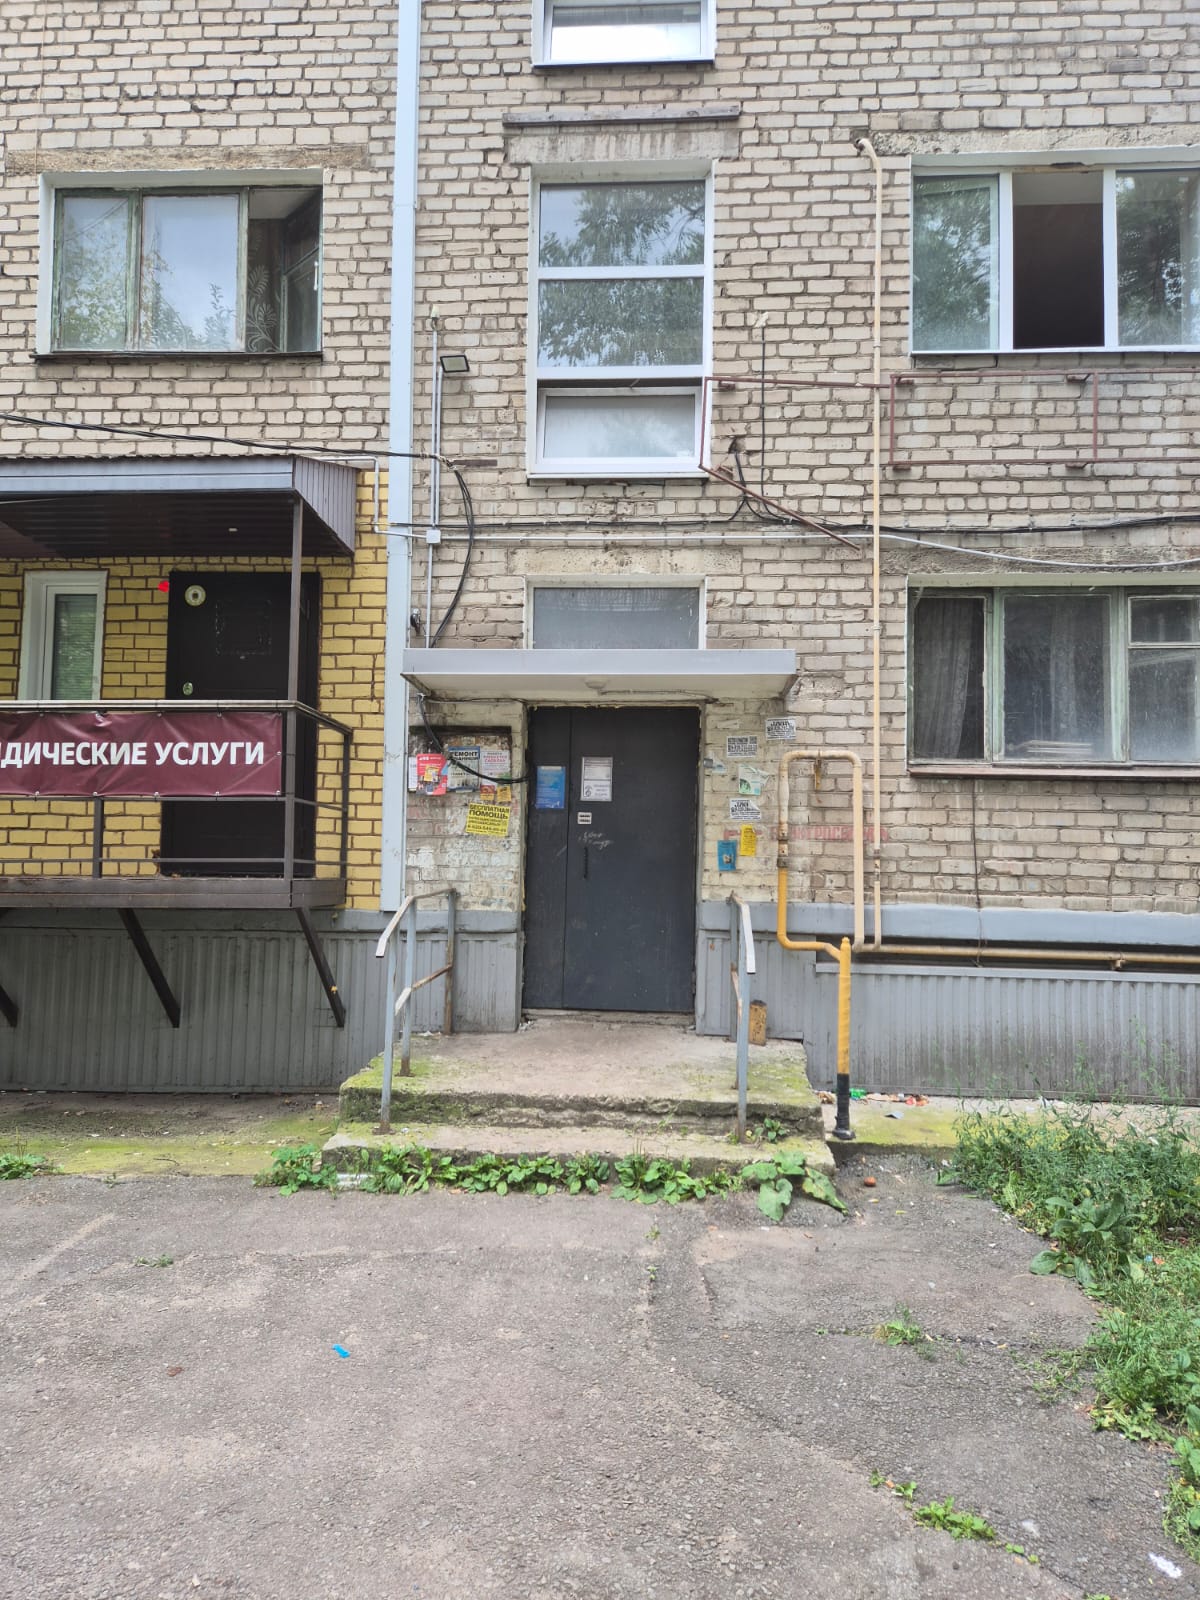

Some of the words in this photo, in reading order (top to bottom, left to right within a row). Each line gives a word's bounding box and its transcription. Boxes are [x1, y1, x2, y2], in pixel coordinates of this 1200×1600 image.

[0, 741, 147, 768] ДИЧЕСКИЕ
[154, 742, 265, 765] УСЛУГИ
[469, 804, 509, 813] БЕСПЛАТНАЯ
[468, 809, 509, 819] ПОМОЩЬ
